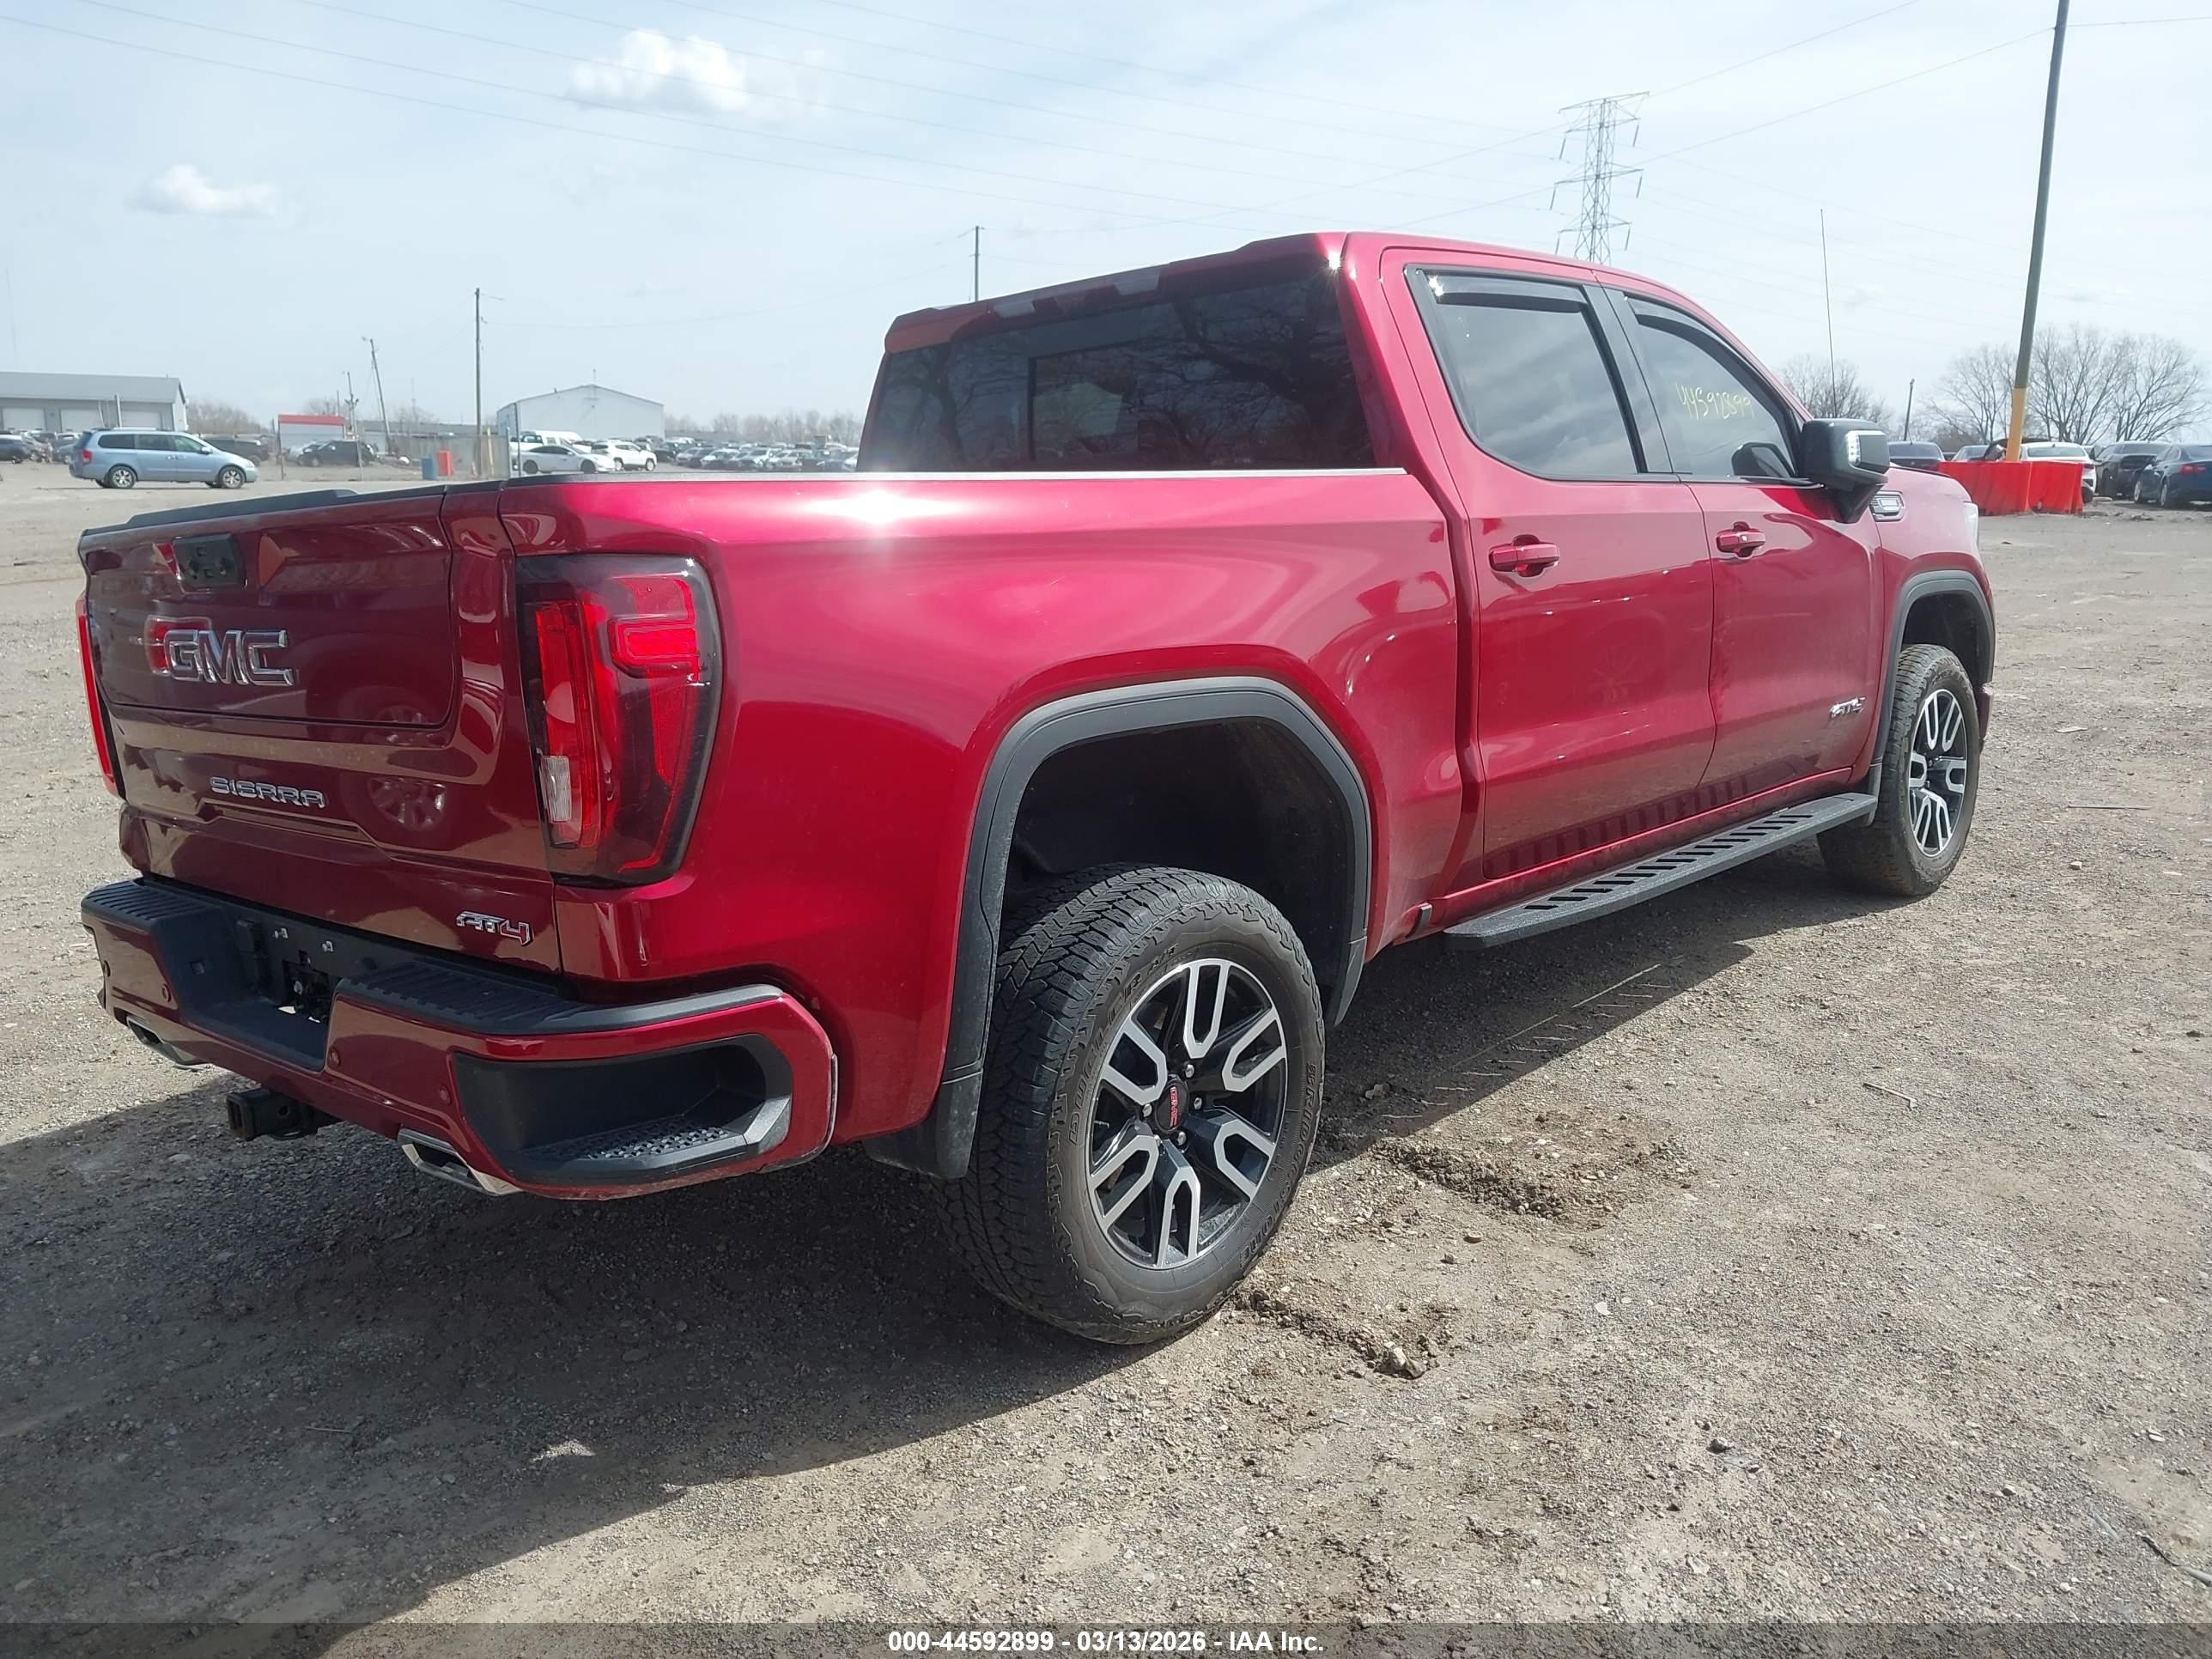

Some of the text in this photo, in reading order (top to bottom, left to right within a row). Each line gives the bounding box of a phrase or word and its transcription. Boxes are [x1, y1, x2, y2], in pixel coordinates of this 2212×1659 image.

[1674, 382, 1757, 421] 44592899
[164, 629, 295, 686] GMC
[210, 776, 325, 808] SIERRA
[455, 909, 534, 947] AT4
[1170, 1085, 1179, 1127] GMC
